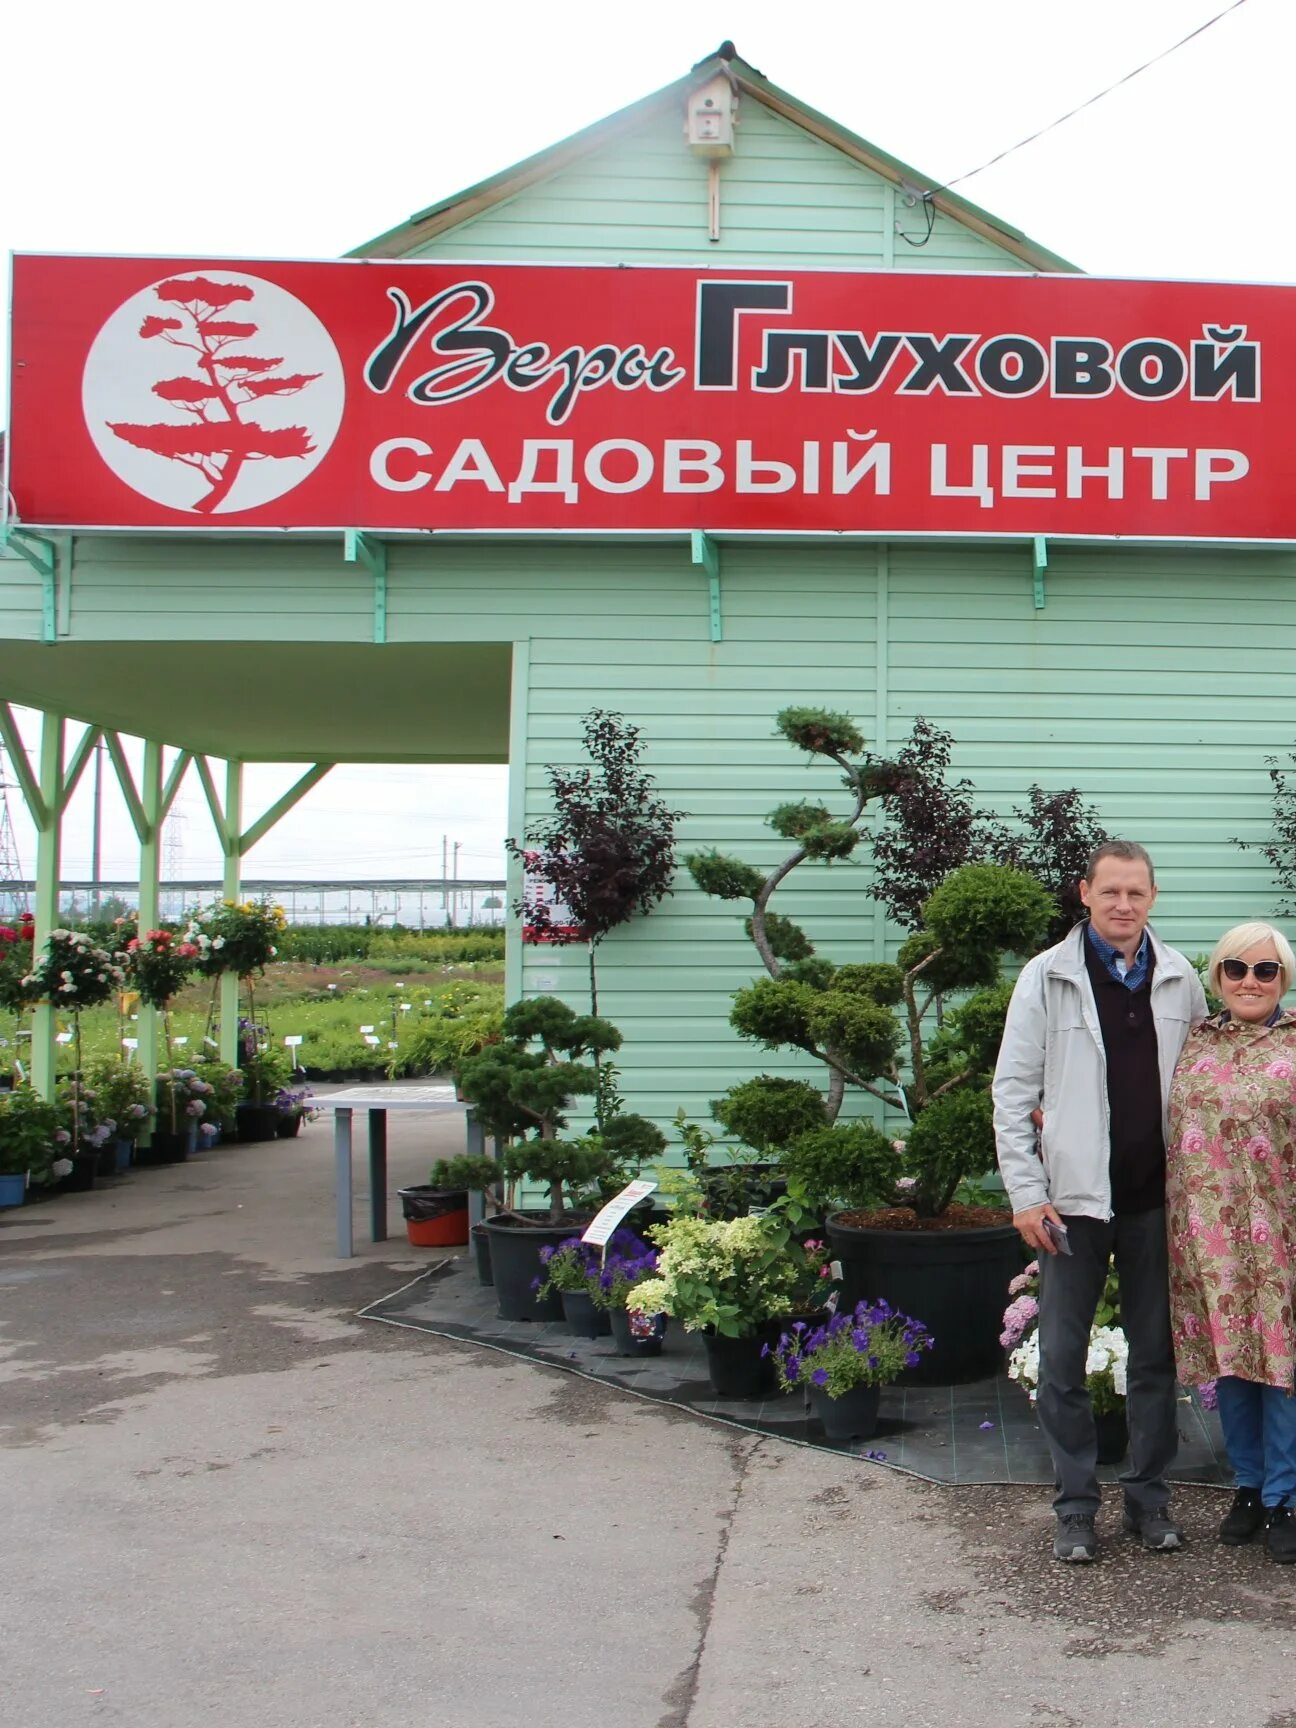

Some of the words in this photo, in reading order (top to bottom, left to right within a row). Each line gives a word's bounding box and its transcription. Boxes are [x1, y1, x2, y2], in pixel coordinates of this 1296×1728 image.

[363, 280, 686, 426] Веры
[368, 428, 892, 505] САДОВЫЙ
[930, 442, 1250, 509] ЦЕНТР
